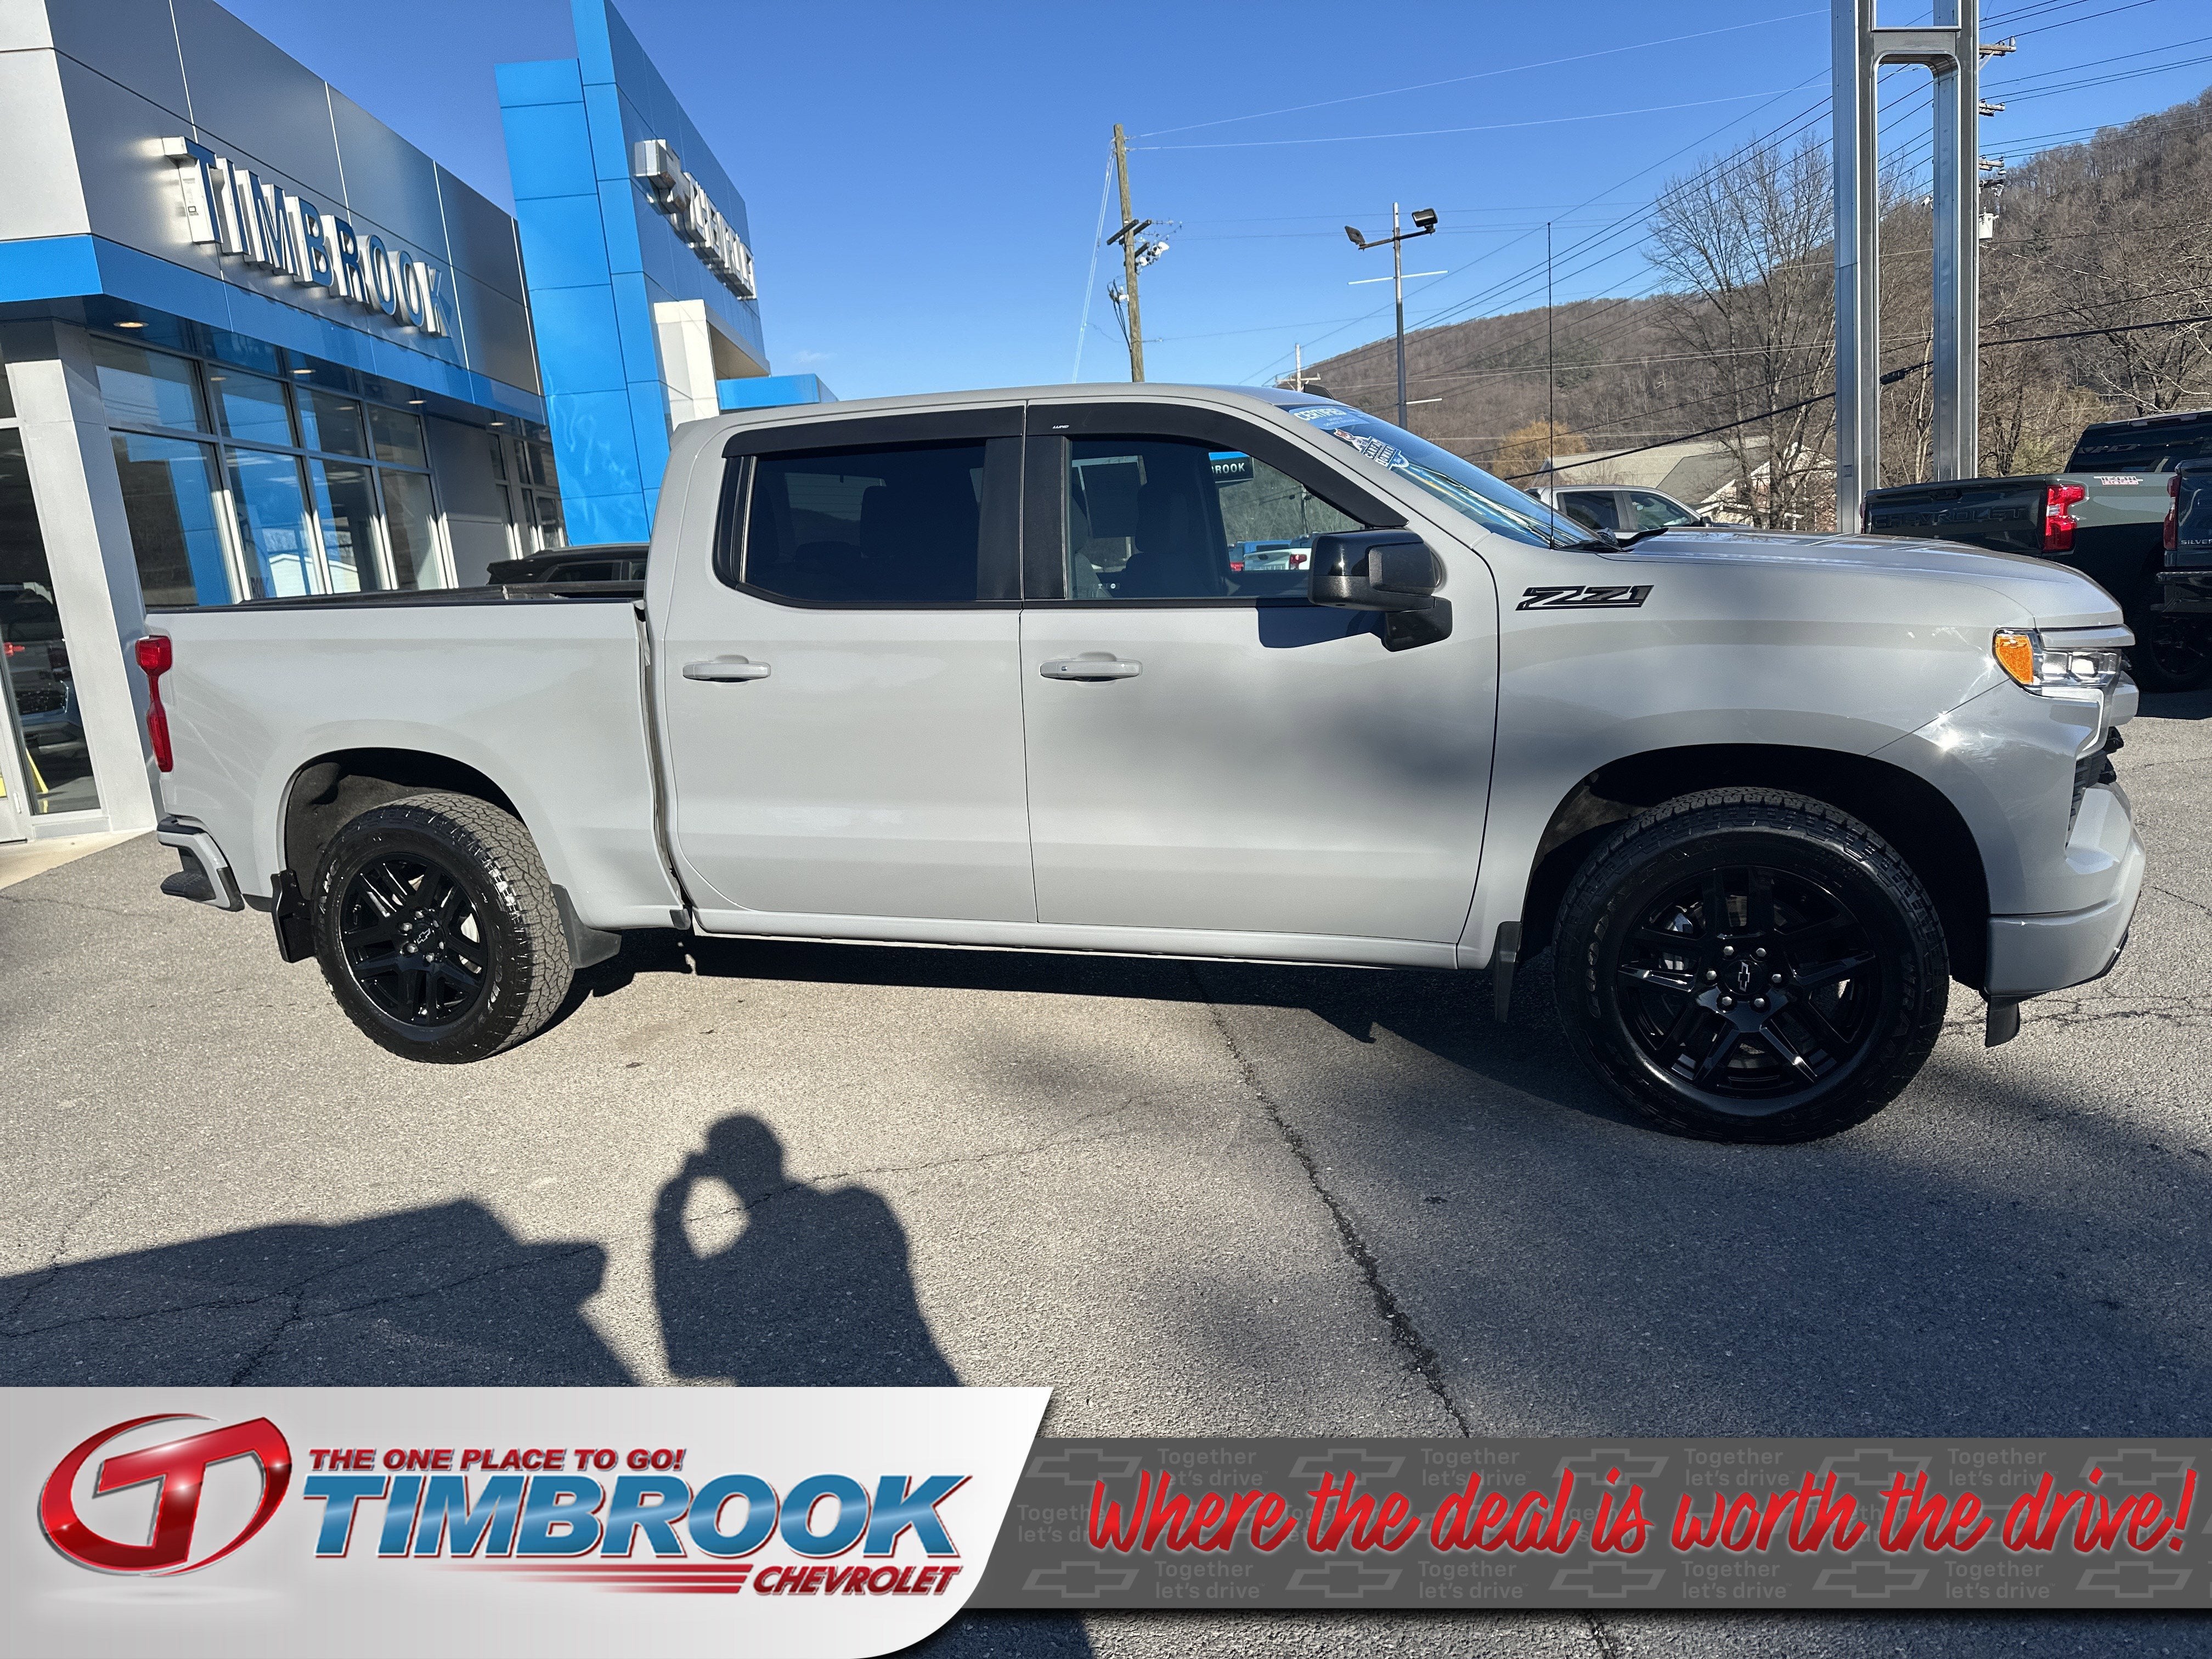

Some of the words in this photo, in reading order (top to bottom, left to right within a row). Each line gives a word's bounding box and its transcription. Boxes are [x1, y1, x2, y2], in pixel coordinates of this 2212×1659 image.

[165, 137, 452, 338] TIMBROOK
[1874, 507, 2028, 528] CHEVROLET
[1515, 585, 1655, 611] Z71
